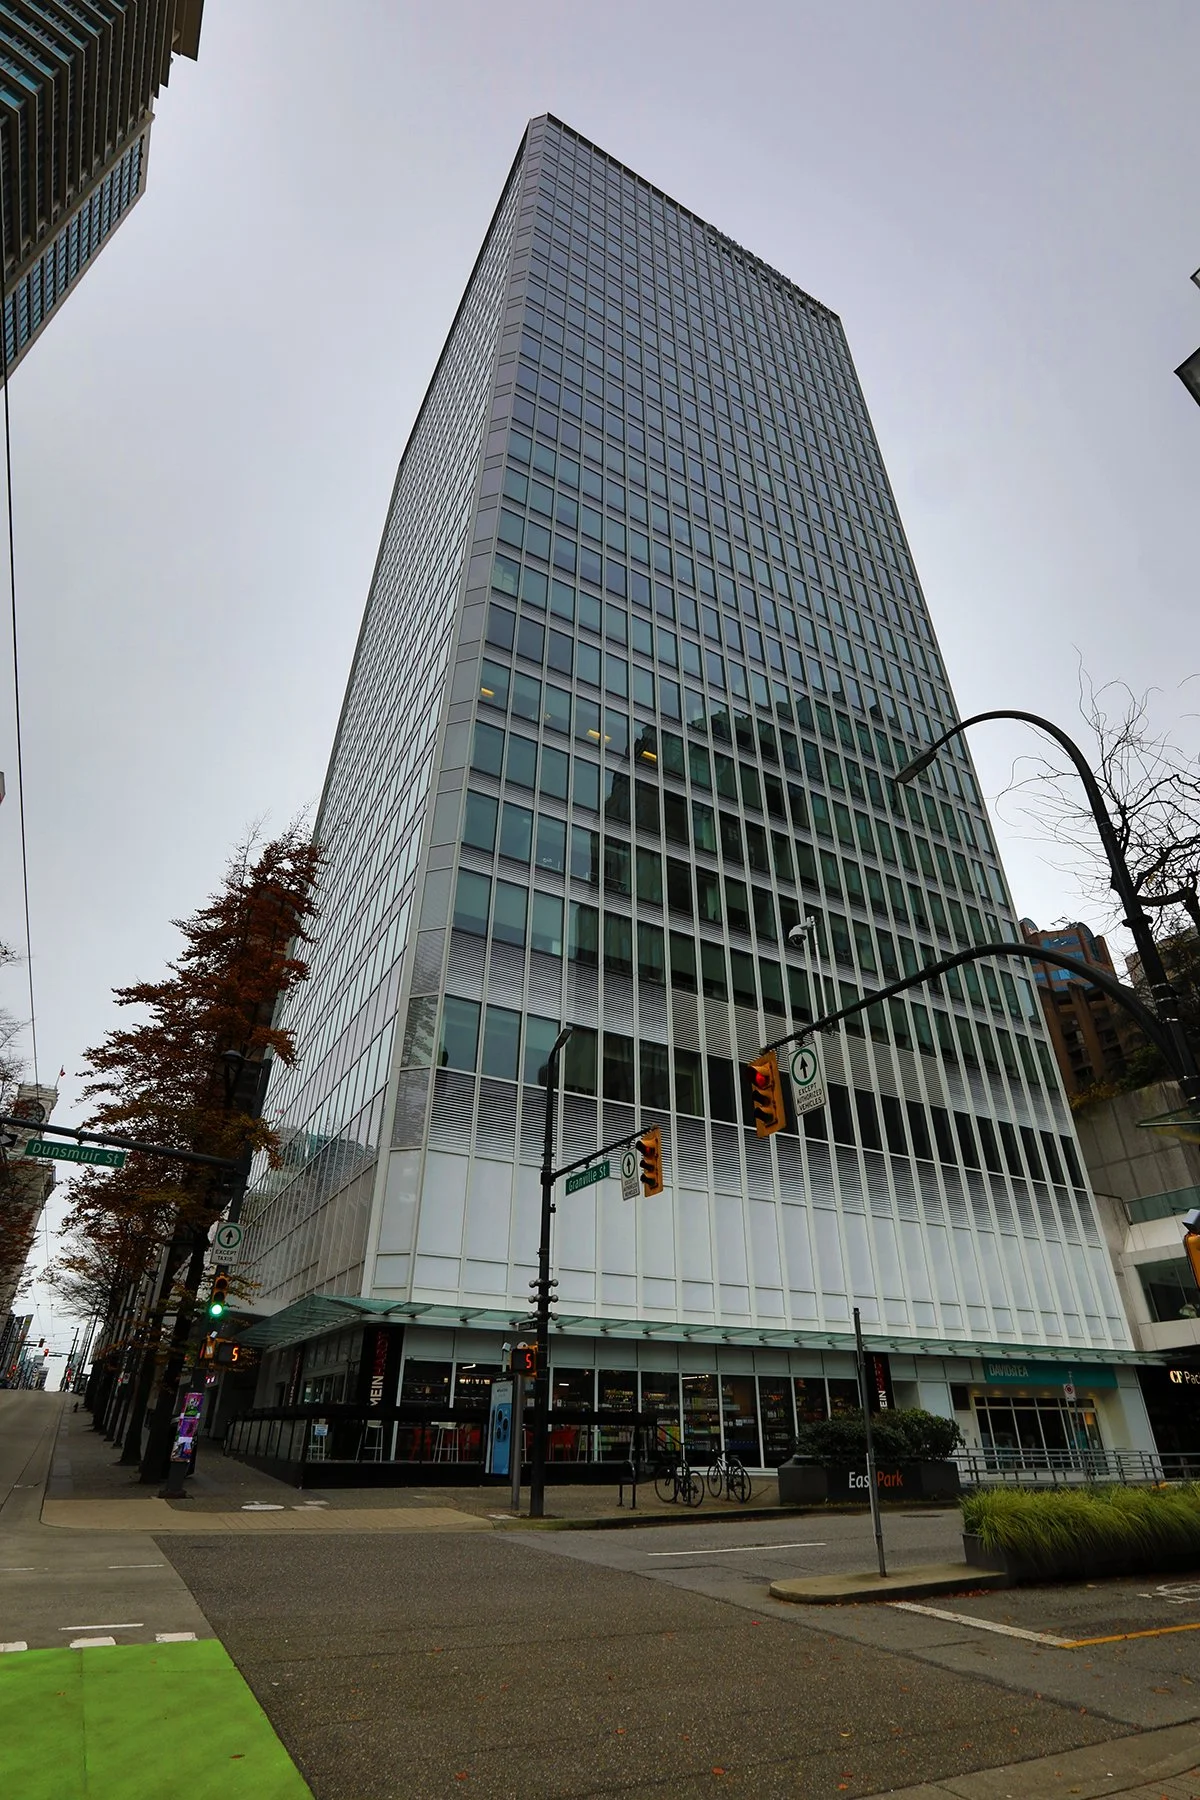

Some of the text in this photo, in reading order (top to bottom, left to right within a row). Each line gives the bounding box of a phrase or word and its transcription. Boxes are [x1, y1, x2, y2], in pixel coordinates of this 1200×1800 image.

[797, 1088, 823, 1104] AUTHORIZED
[798, 1082, 817, 1096] EXCEPT
[799, 1096, 823, 1111] VEHICLES
[31, 1142, 119, 1166] Dunsmuir St
[568, 1165, 607, 1191] Granville St
[231, 1347, 239, 1361] 5
[525, 1353, 532, 1369] 5
[1169, 1370, 1200, 1385] CF Pac
